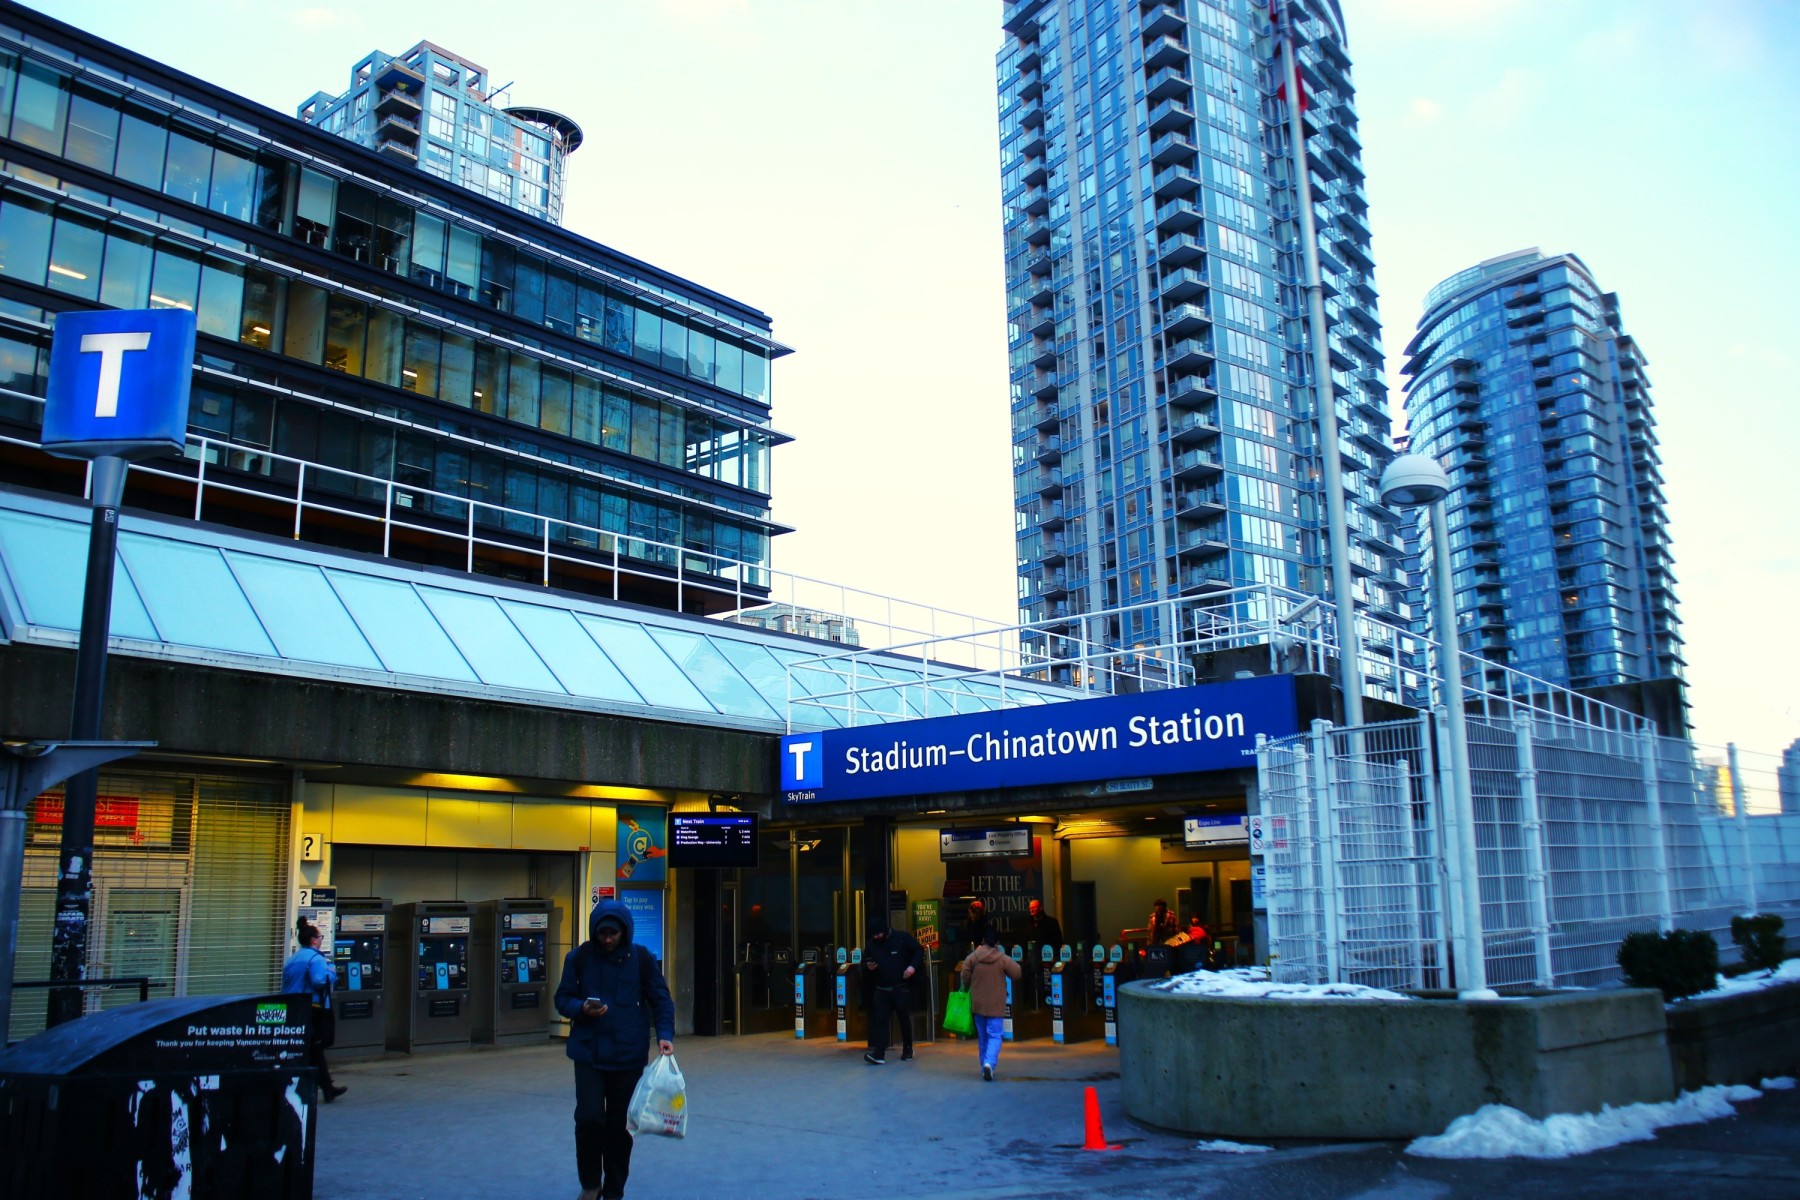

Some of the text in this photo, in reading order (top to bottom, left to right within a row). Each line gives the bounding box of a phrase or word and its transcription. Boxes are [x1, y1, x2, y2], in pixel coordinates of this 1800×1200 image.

[80, 332, 151, 417] T
[1128, 708, 1245, 748] Station
[788, 742, 813, 781] T
[787, 791, 816, 802] SkyTrain
[971, 875, 1022, 892] LET THE
[624, 896, 633, 904] Tap
[188, 1025, 305, 1036] Put waste in its place!
[206, 1040, 234, 1048] keeping
[272, 1038, 288, 1046] litter
